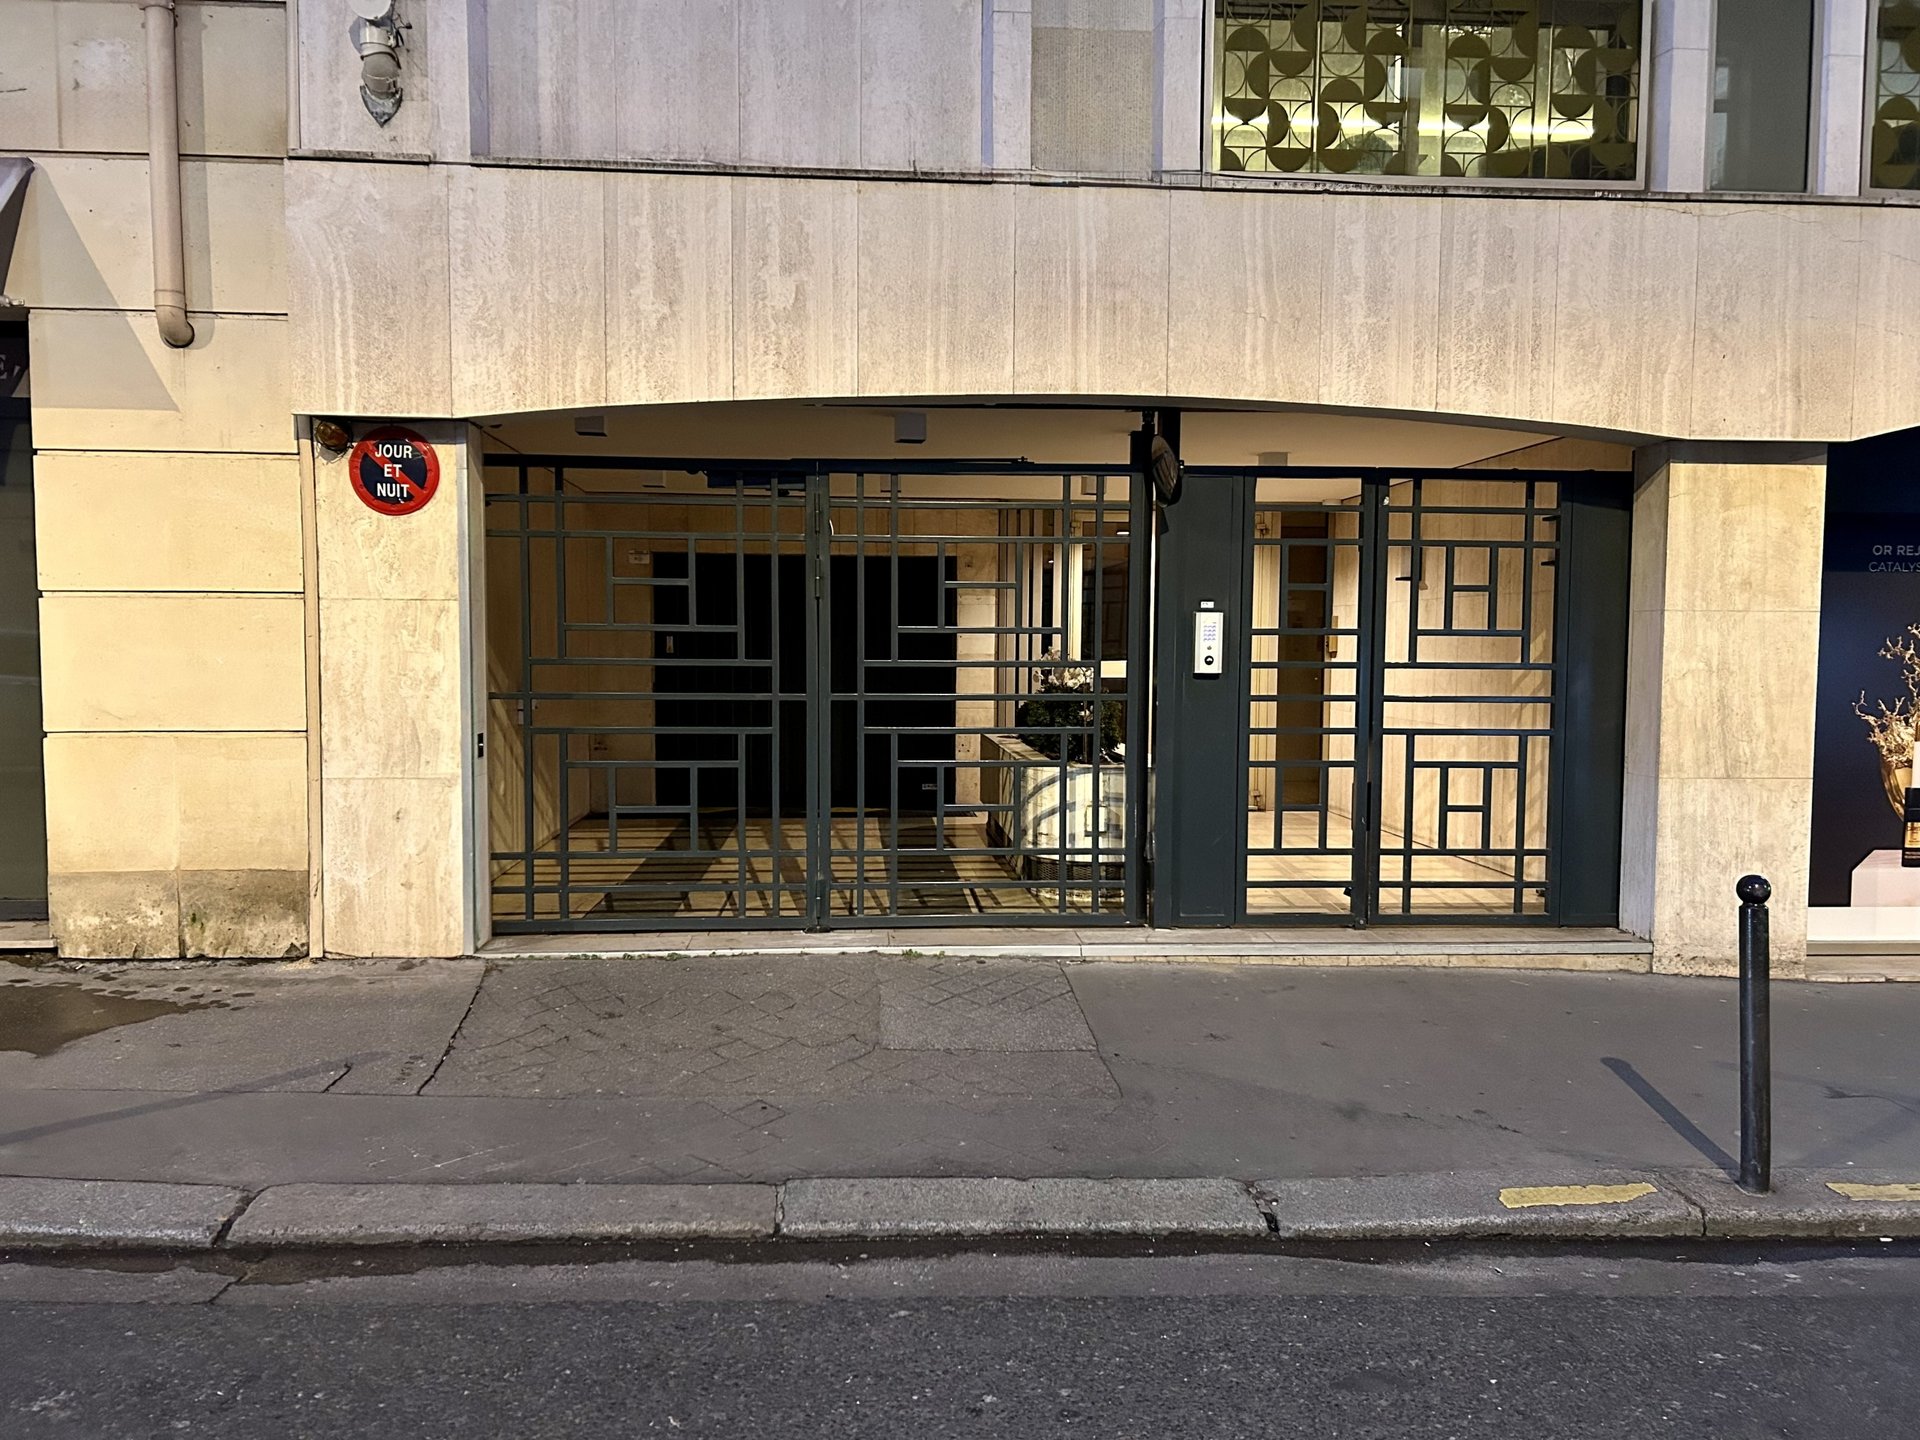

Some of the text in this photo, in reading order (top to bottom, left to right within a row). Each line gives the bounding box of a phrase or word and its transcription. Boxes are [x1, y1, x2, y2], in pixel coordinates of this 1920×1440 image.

[375, 444, 412, 459] JOUR
[384, 464, 402, 477] ET
[376, 483, 409, 498] NUIT
[1872, 544, 1892, 556] OR
